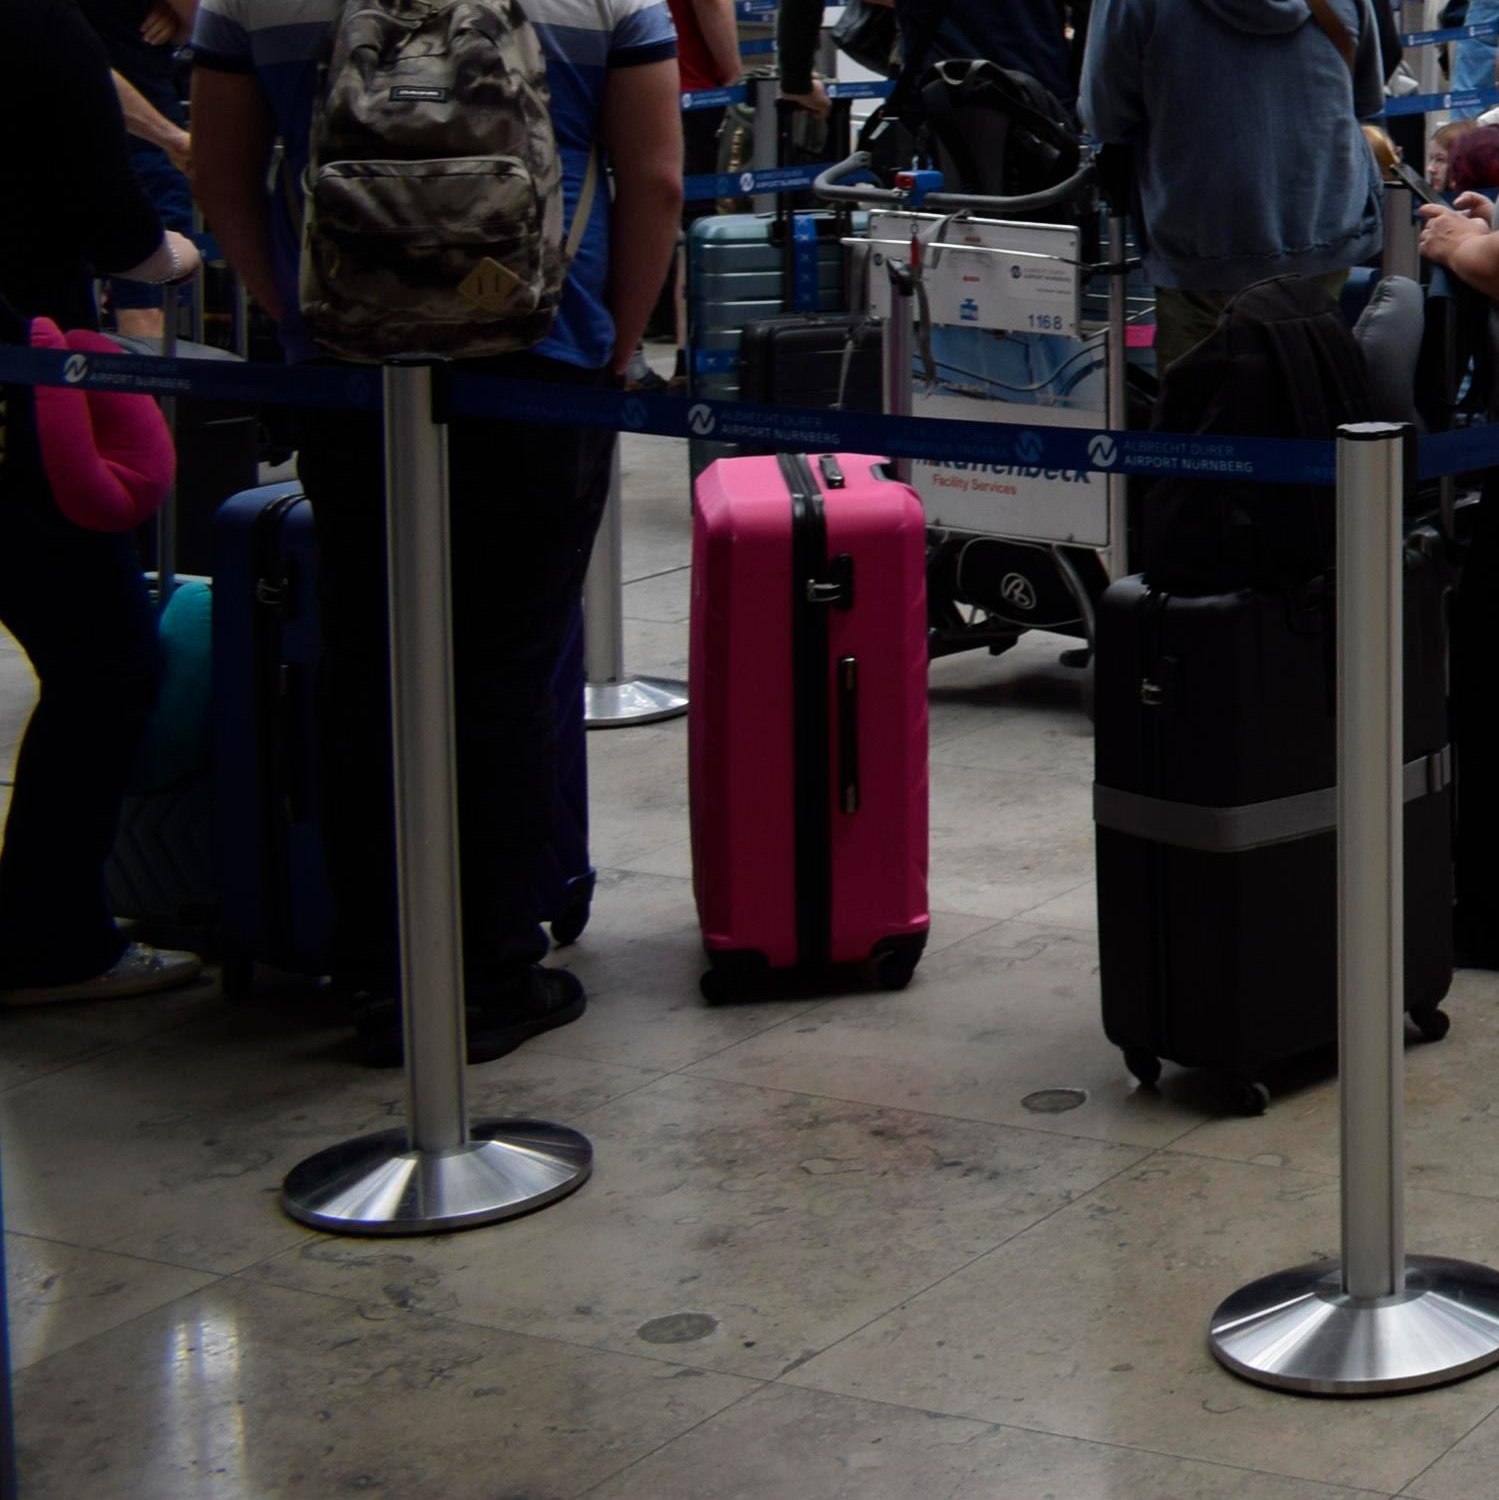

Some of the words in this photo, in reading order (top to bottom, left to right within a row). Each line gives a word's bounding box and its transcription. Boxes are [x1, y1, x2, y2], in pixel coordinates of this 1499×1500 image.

[1028, 313, 1063, 330] 1168
[720, 423, 772, 438] AIRPORT
[1123, 440, 1187, 454] ALBRECHT
[1124, 455, 1178, 469] AIRPORT
[933, 473, 968, 490] Facility
[971, 478, 1017, 495] Services
